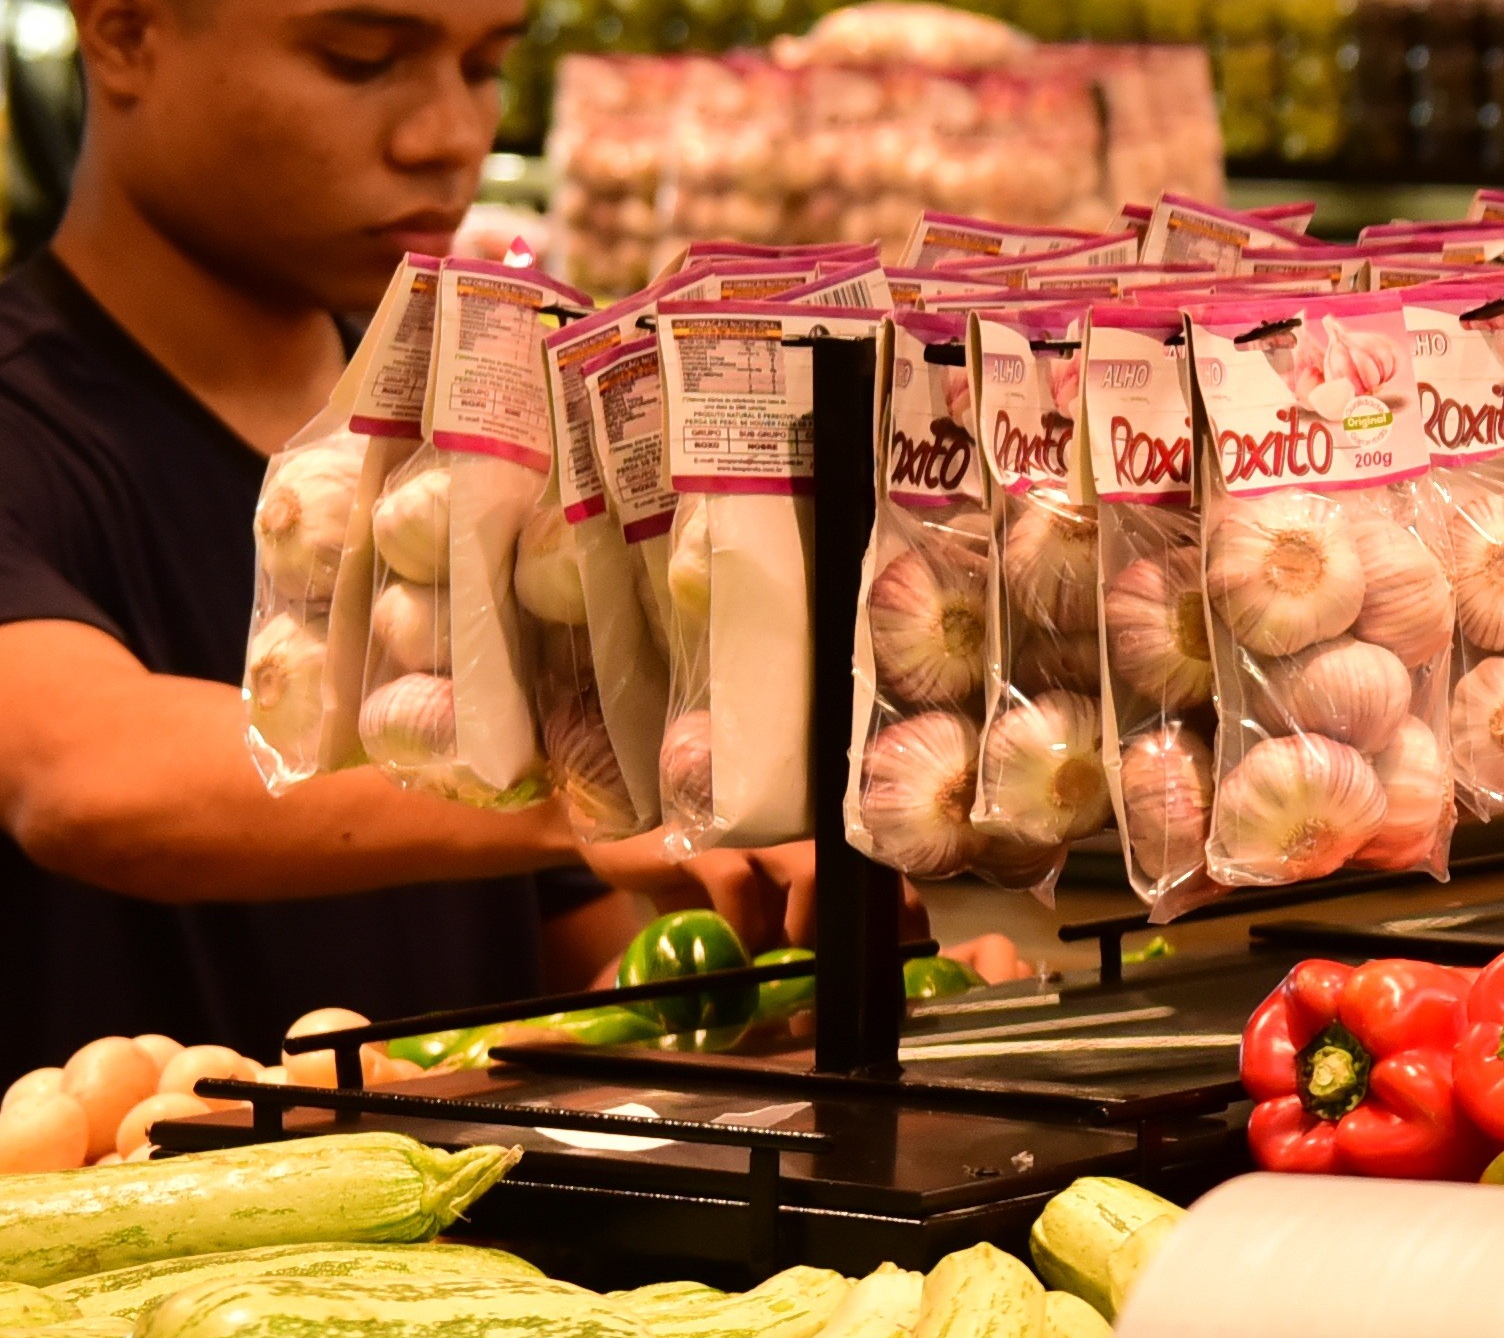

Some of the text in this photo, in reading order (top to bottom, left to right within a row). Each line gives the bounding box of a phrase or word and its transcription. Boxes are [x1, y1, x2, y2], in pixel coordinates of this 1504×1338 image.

[1415, 332, 1448, 357] HO
[992, 360, 1025, 384] ALHO
[1101, 364, 1150, 388] ALHO
[692, 429, 721, 437] GRUPO
[1347, 413, 1387, 429] Original
[1111, 414, 1191, 487] Roxi
[1212, 406, 1333, 485] oxito
[1355, 450, 1393, 469] 200g
